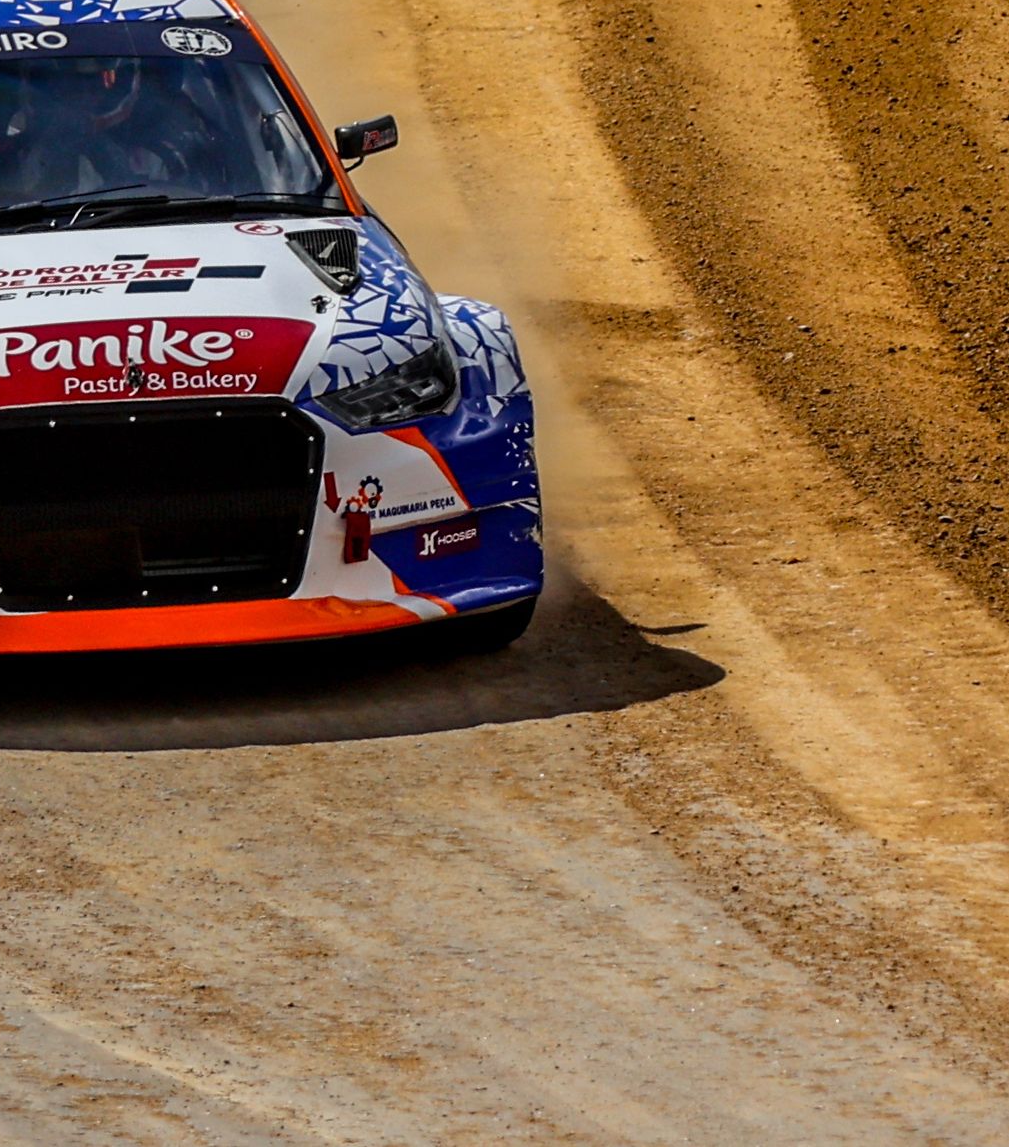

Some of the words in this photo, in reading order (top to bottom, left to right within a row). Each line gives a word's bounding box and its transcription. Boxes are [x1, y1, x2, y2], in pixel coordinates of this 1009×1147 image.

[165, 30, 226, 53] FIA
[38, 269, 185, 286] BALTAR
[26, 286, 106, 299] PARK
[146, 372, 167, 390] &
[171, 370, 258, 393] Bakery
[378, 502, 429, 519] MAQUINARIA
[430, 495, 457, 511] PEÇAS
[437, 527, 478, 547] HOOSIER
